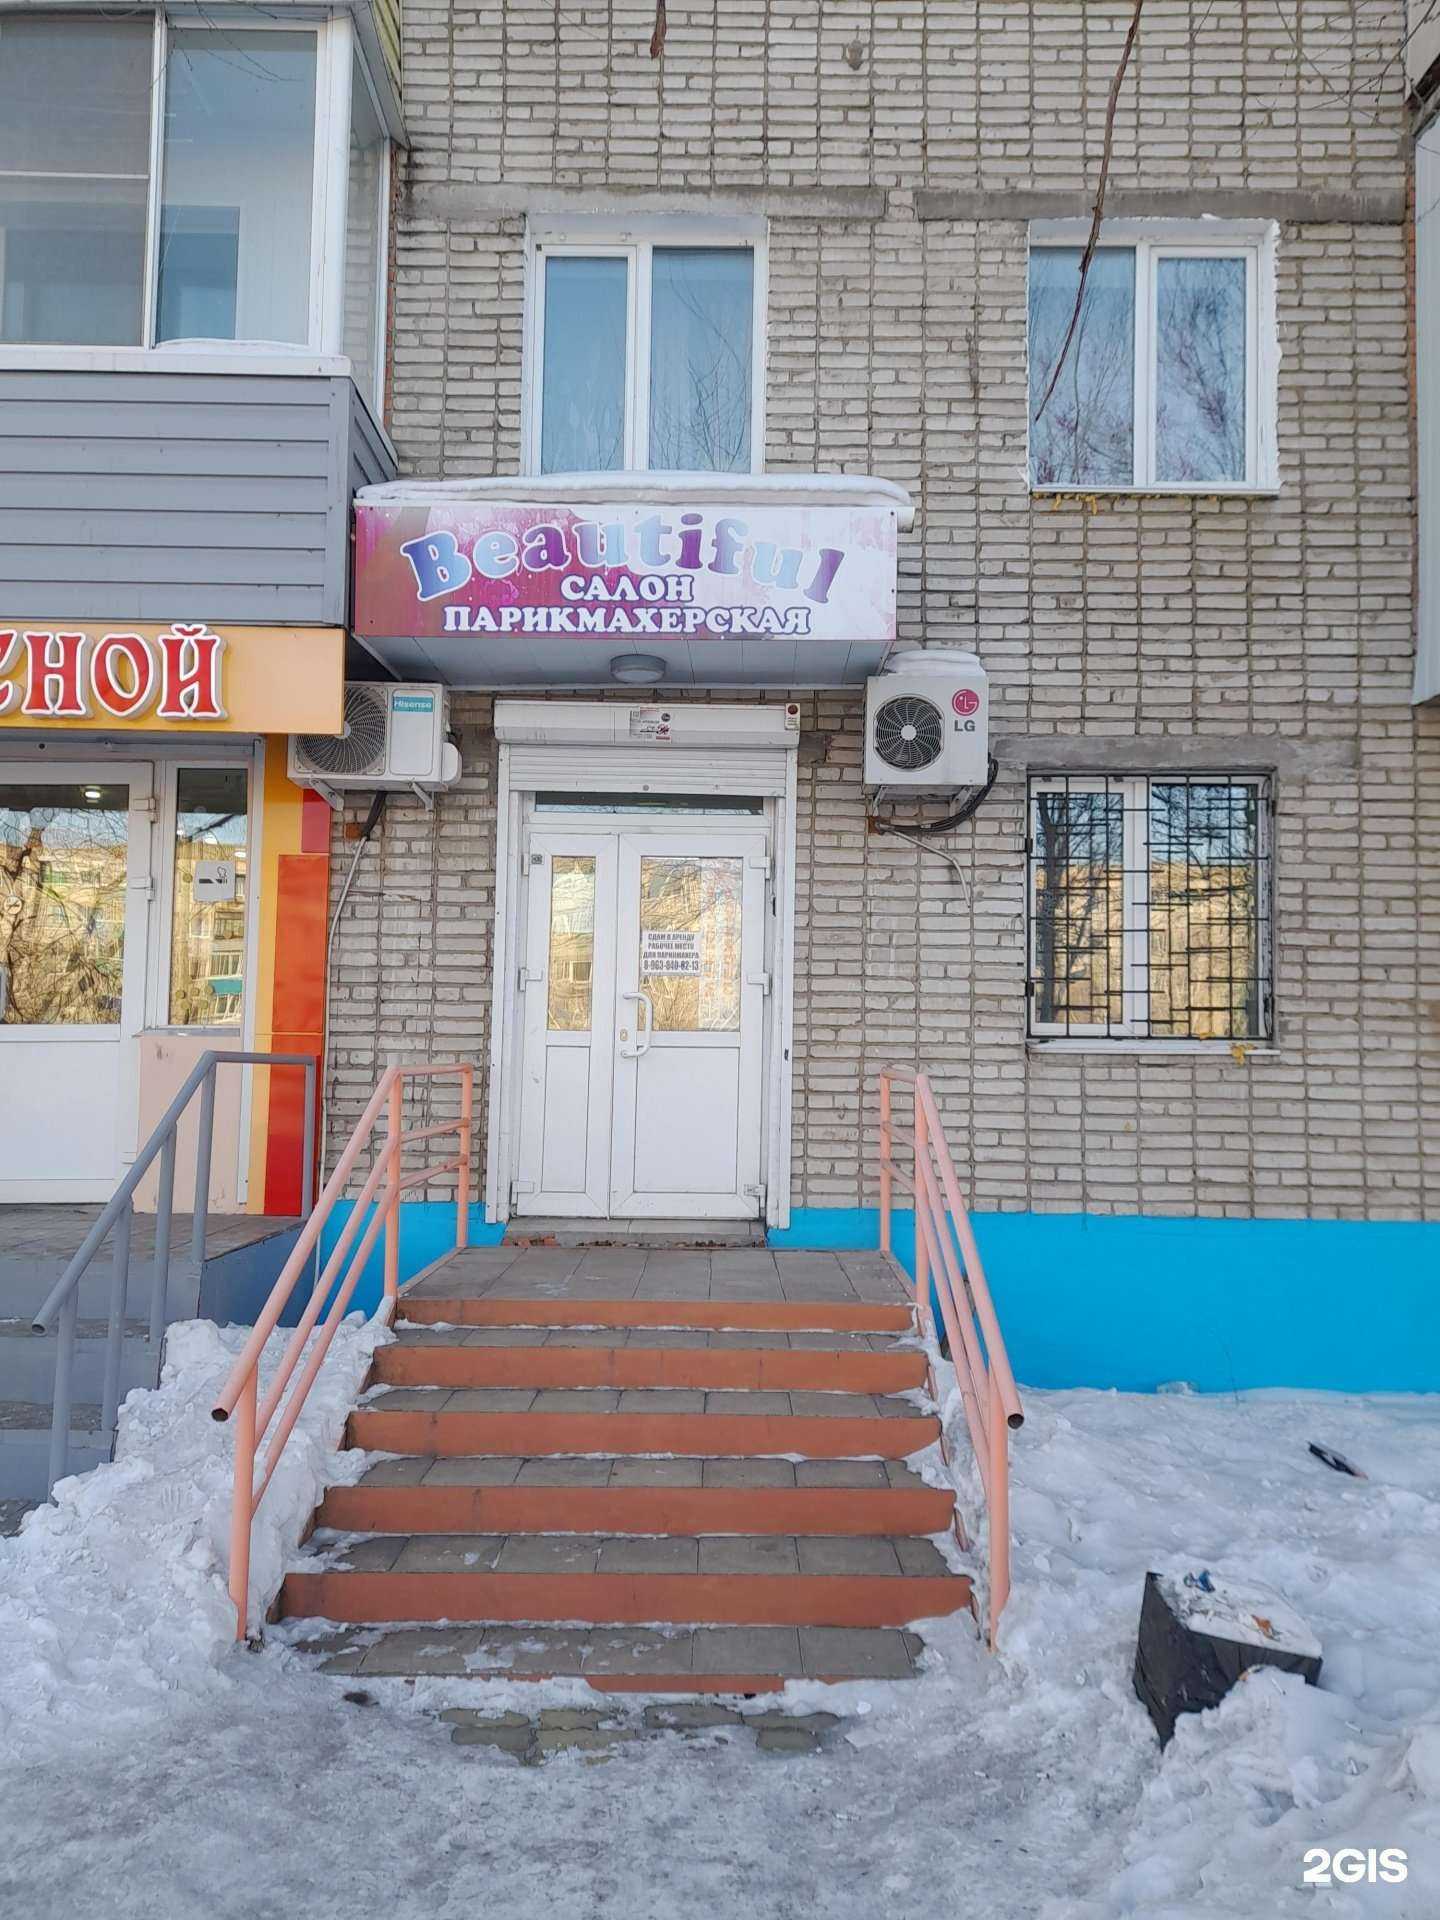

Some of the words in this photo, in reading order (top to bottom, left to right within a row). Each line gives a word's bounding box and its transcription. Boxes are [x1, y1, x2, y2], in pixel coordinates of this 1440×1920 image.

[400, 512, 846, 604] Beautiful
[559, 573, 694, 602] САЛОН
[443, 605, 812, 635] ПАРИКМАХЕРСКАЯ
[393, 700, 432, 708] Hisense
[954, 719, 976, 732] LG
